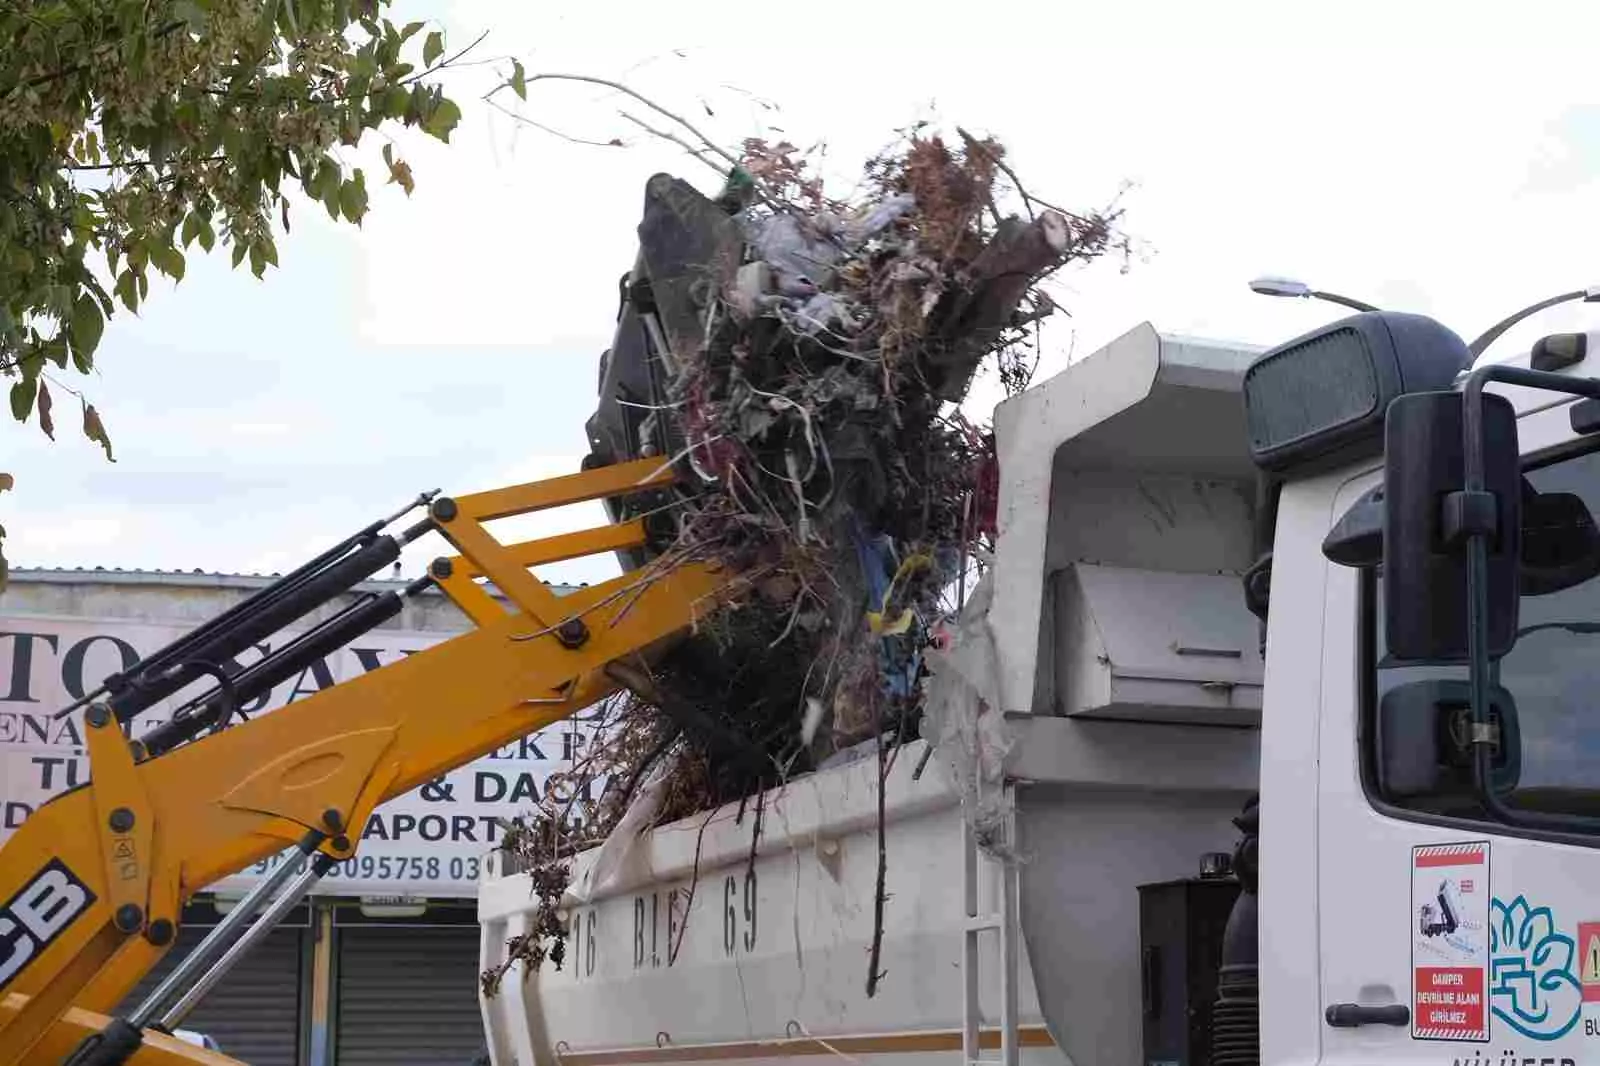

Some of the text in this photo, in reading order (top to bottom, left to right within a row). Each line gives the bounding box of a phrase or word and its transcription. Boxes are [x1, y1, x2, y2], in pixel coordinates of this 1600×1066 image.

[573, 909, 597, 980] 16
[724, 872, 757, 958] 69
[1432, 973, 1463, 985] DAMPER
